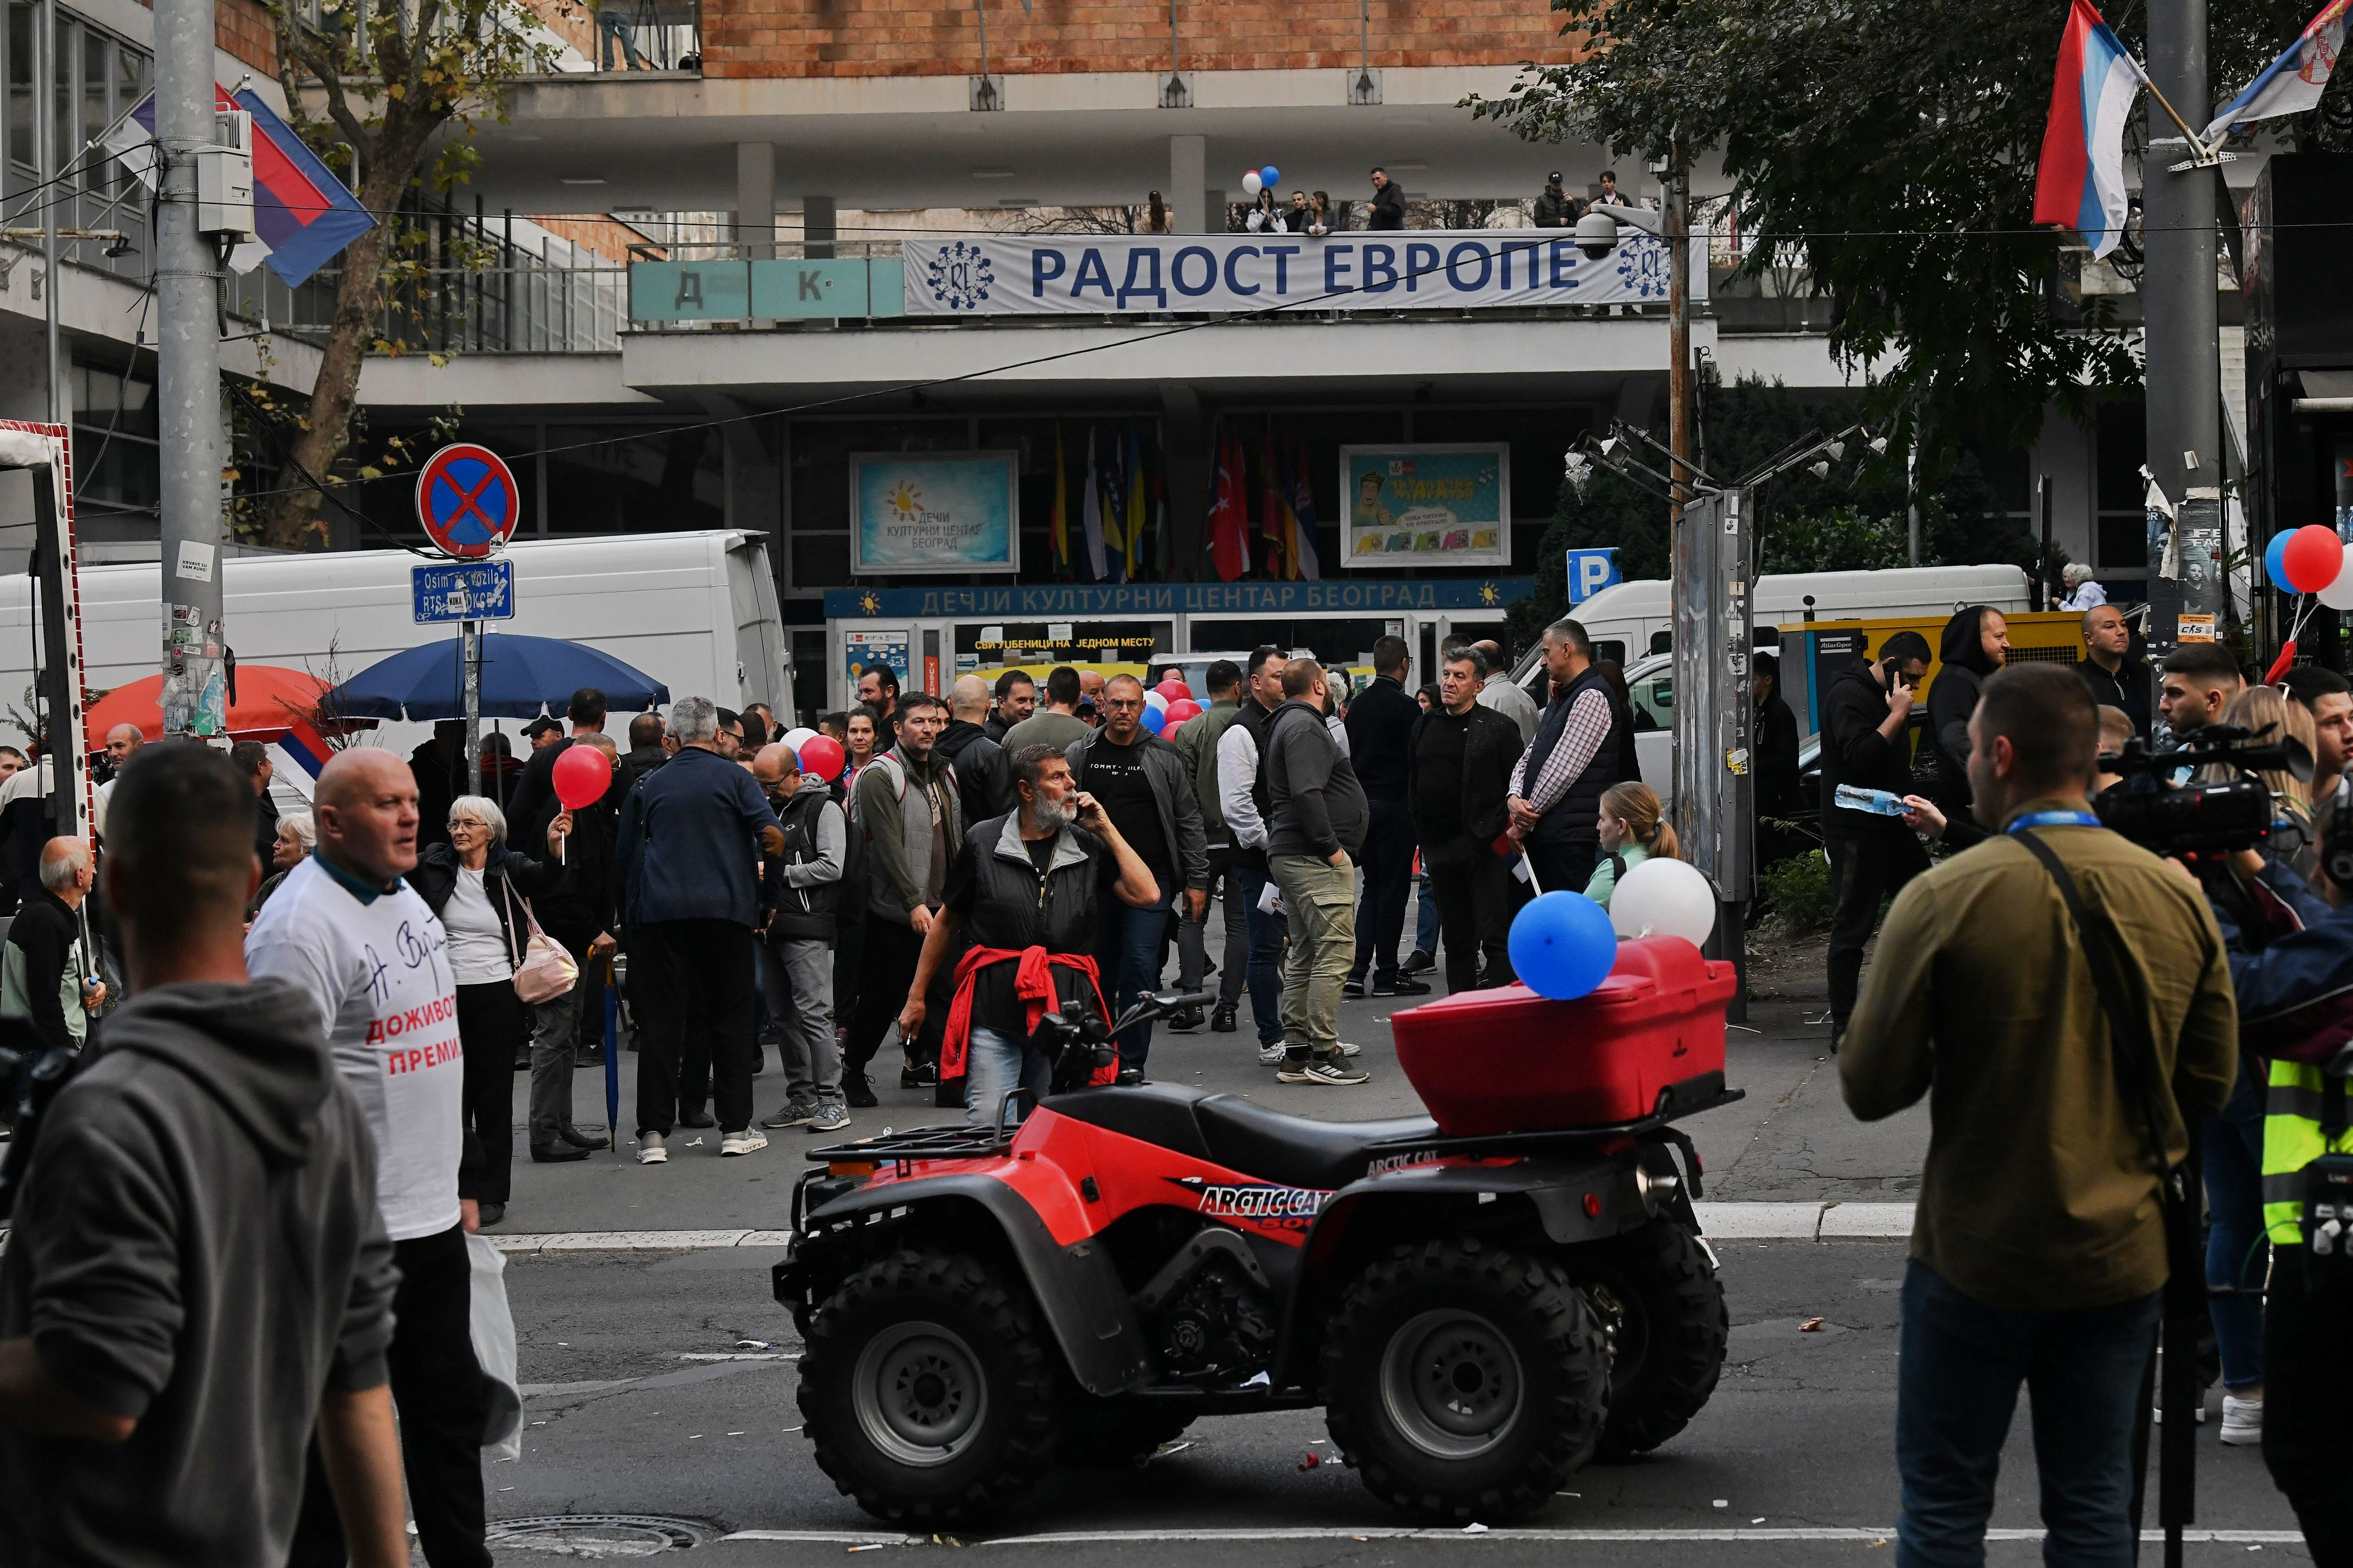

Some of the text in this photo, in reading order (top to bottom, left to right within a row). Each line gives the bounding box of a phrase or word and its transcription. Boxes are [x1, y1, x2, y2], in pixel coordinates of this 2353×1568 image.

[1032, 240, 1579, 309] РАДОСТ ЕВРОПЕ
[675, 269, 822, 311] Д К
[886, 523, 983, 537] КУЛТУРНИ ЦЕНТАР
[918, 512, 950, 525] ДЕЧЈИ
[912, 538, 958, 550] БЕОГРАД
[425, 573, 449, 589] Osim
[1579, 556, 1609, 597] P
[449, 596, 462, 606] KUKA
[921, 584, 1437, 616] ДЕЧЈИ КУЛТУРНИ ЦЕНТАР БЕОГРАД
[975, 637, 1155, 650] СВИ УЏБЕНИЦИ НА ЈЕДНОМ МЕСТУ
[389, 1037, 463, 1075] ПРЕМИ
[1368, 1150, 1439, 1177] ARCTIC CAT
[1198, 1187, 1331, 1217] ARCTIC CAT
